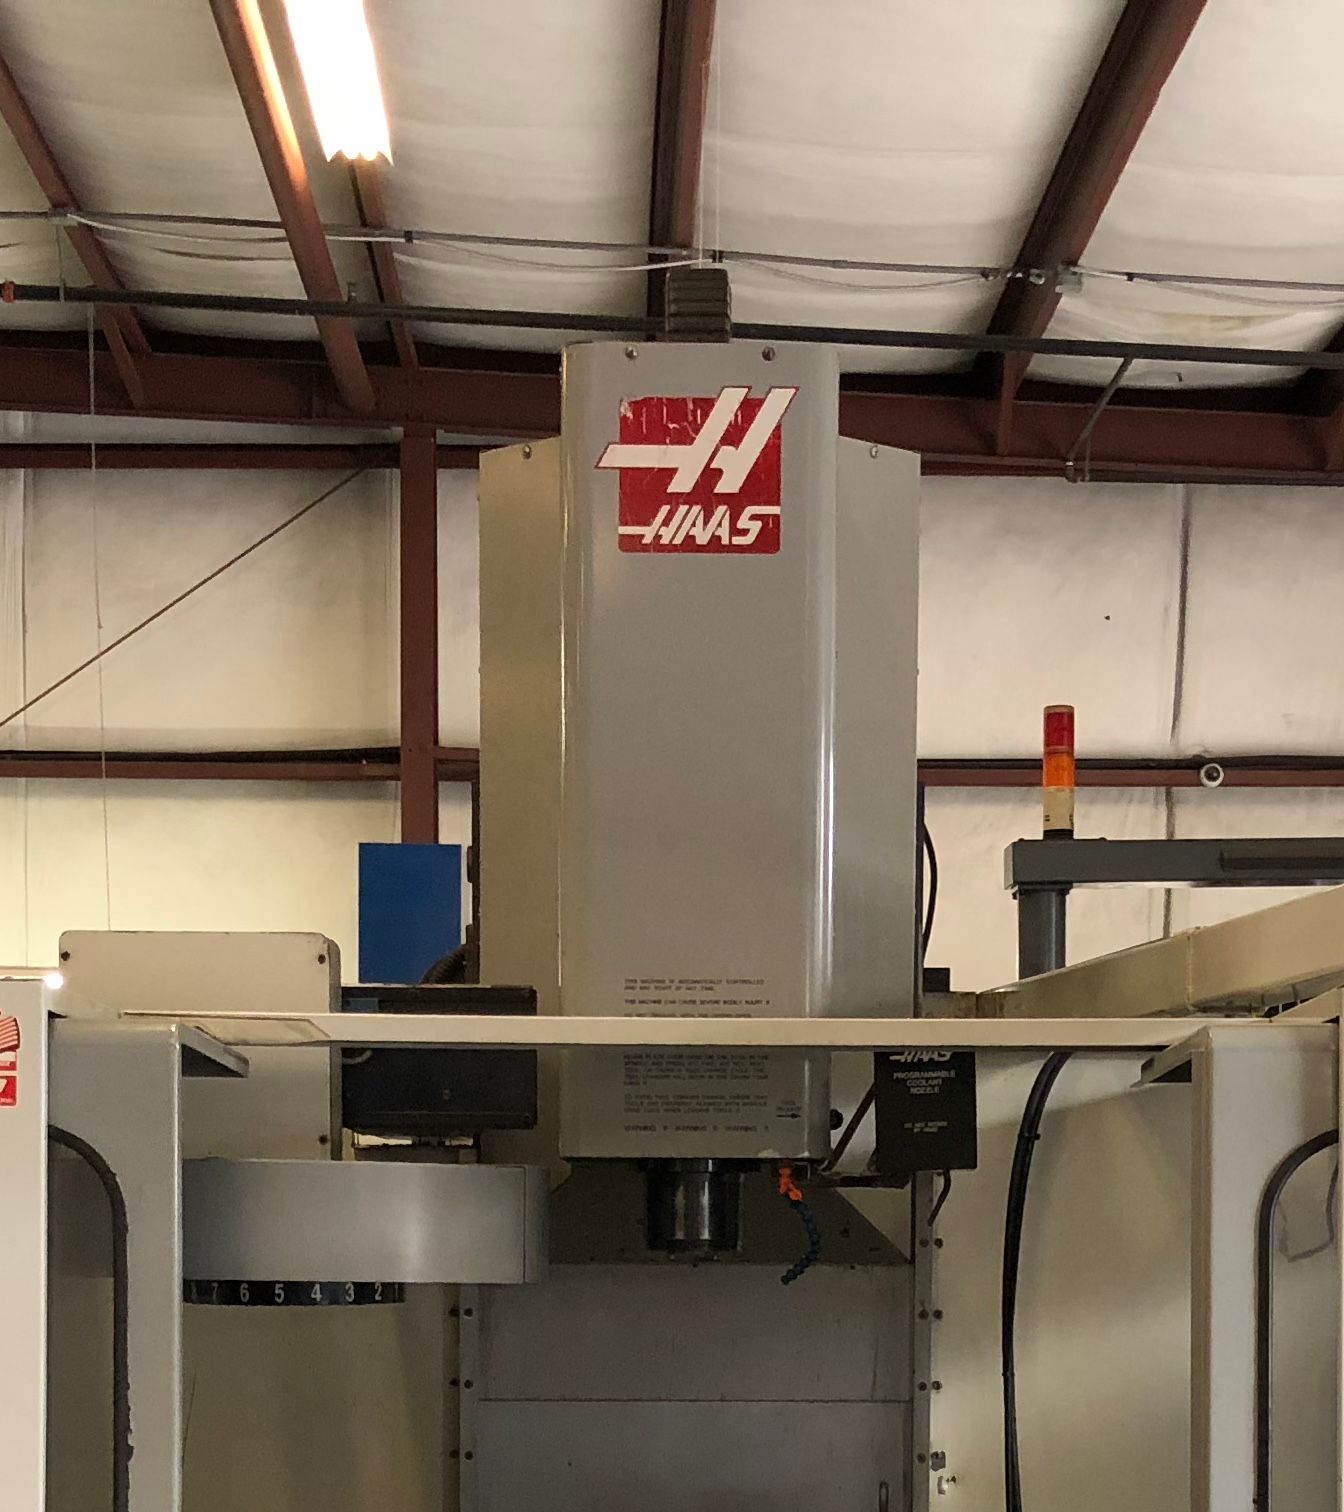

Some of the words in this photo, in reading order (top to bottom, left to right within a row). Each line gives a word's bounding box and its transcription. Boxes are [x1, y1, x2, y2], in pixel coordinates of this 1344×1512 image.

[618, 505, 781, 545] HAAS
[210, 1282, 219, 1300] 7
[239, 1282, 250, 1303] 6
[274, 1283, 285, 1304] 5
[310, 1283, 323, 1302] 4
[344, 1283, 355, 1302] 3
[374, 1282, 383, 1301] 2
